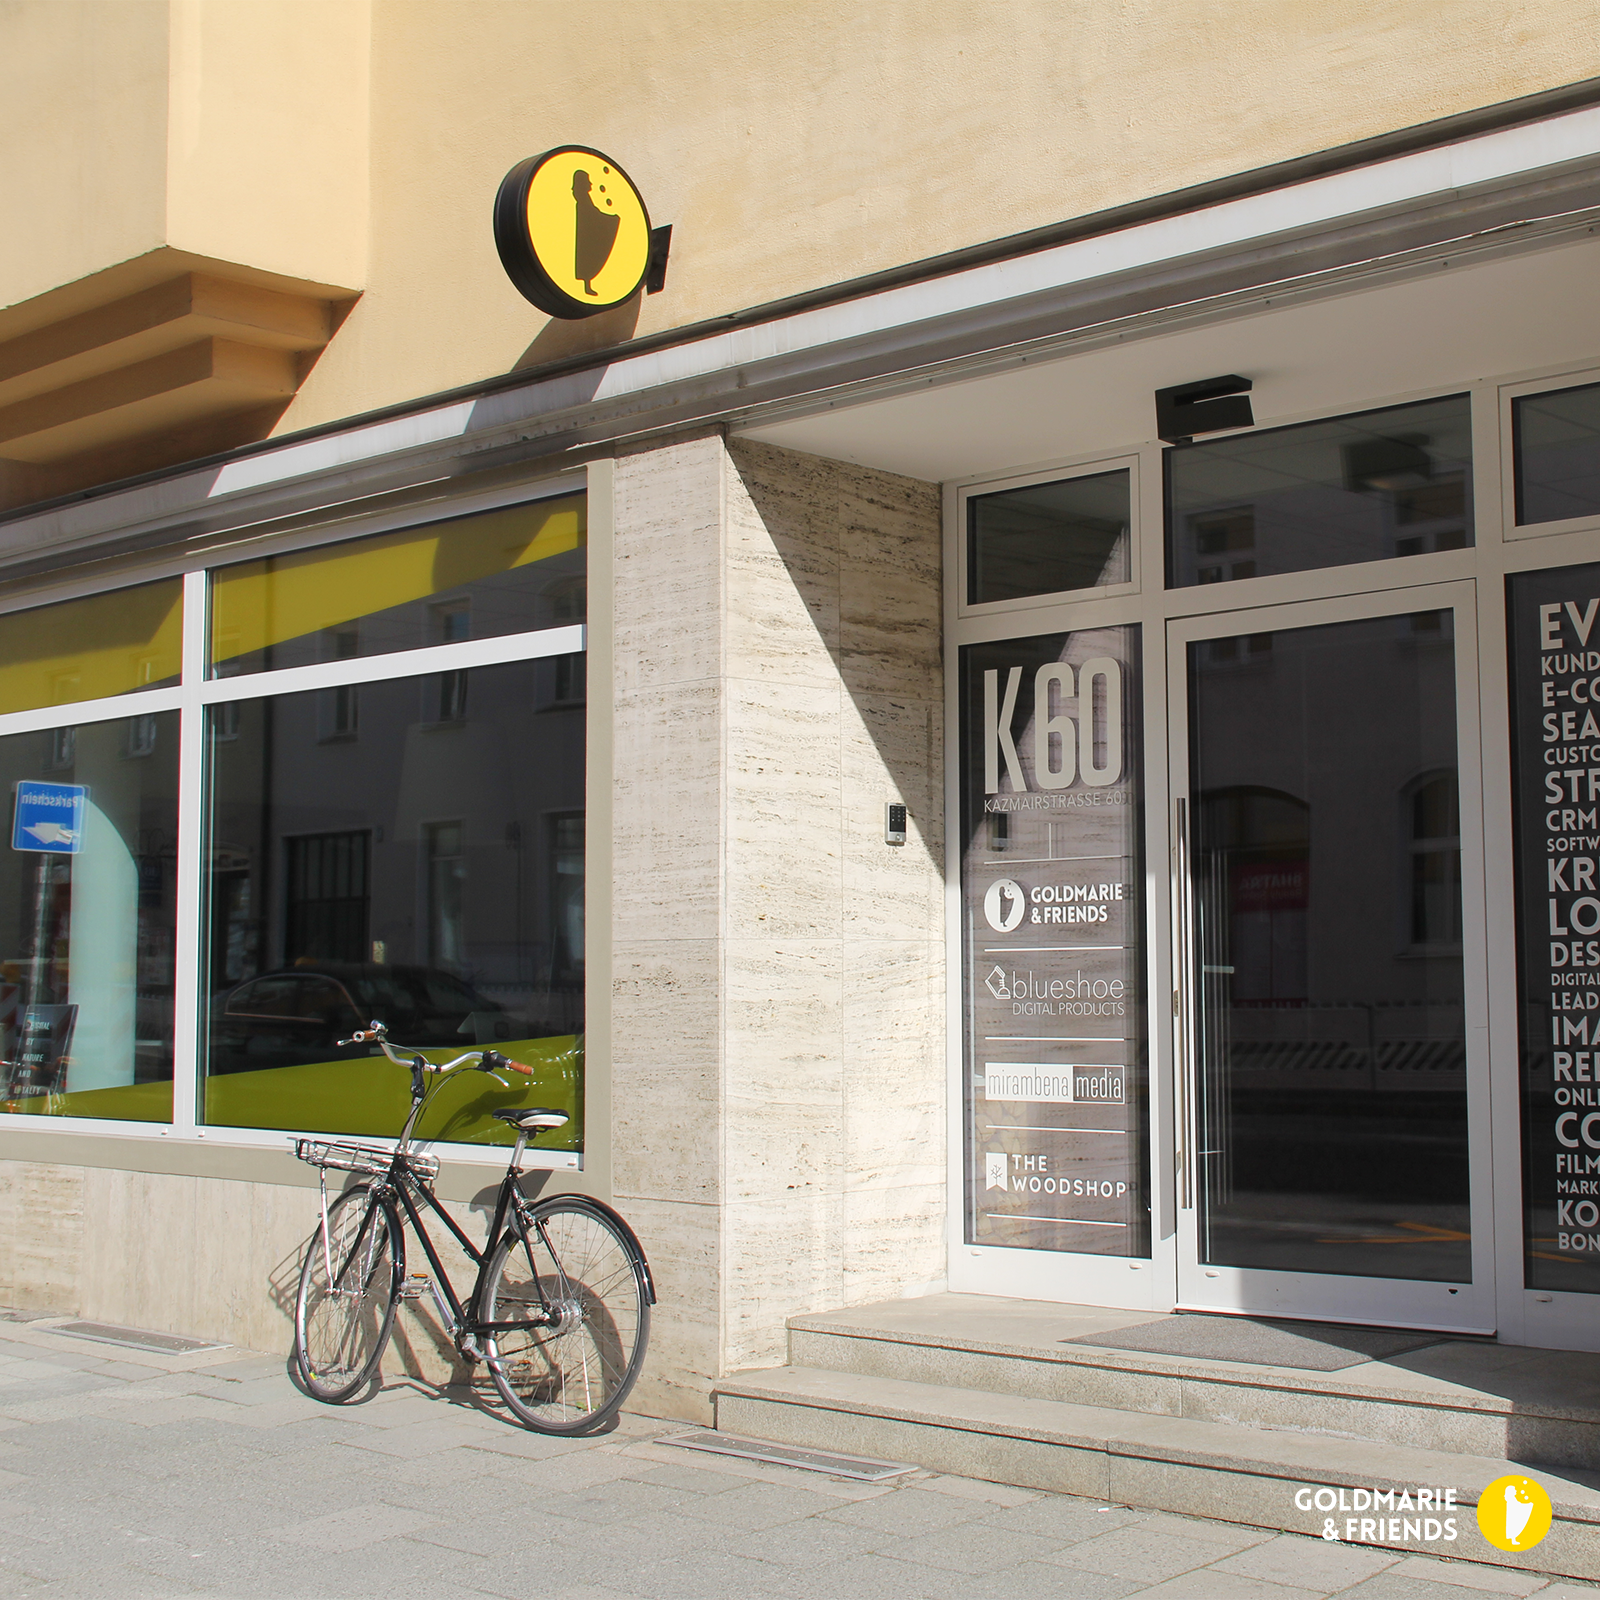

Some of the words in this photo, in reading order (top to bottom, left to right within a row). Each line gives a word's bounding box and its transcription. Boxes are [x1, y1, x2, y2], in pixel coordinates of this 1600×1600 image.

[1539, 598, 1600, 650] EV
[1541, 651, 1600, 676] KUND
[1542, 708, 1600, 742] SEA
[984, 794, 1100, 813] KAZMAIRSTRASSE
[1106, 791, 1121, 805] 60
[1545, 807, 1597, 832] CRM
[1547, 835, 1600, 852] SOFTW
[1547, 856, 1600, 892] KR
[1031, 883, 1123, 903] GOLDMARIE
[1549, 896, 1600, 936] LO
[1550, 941, 1600, 967] DES
[1012, 970, 1124, 999] blueshoe
[1012, 1002, 1056, 1015] DIGITAL
[1059, 1002, 1125, 1016] PRODUCTS
[1551, 991, 1599, 1010] LEAD
[988, 1066, 1069, 1097] mirambena
[1076, 1068, 1122, 1099] media
[1555, 1111, 1600, 1149] CO
[1012, 1154, 1048, 1172] THE
[1556, 1153, 1600, 1174] FILM
[1012, 1175, 1126, 1198] WOODSHOP
[1557, 1199, 1599, 1228] KO
[1558, 1232, 1600, 1252] BON
